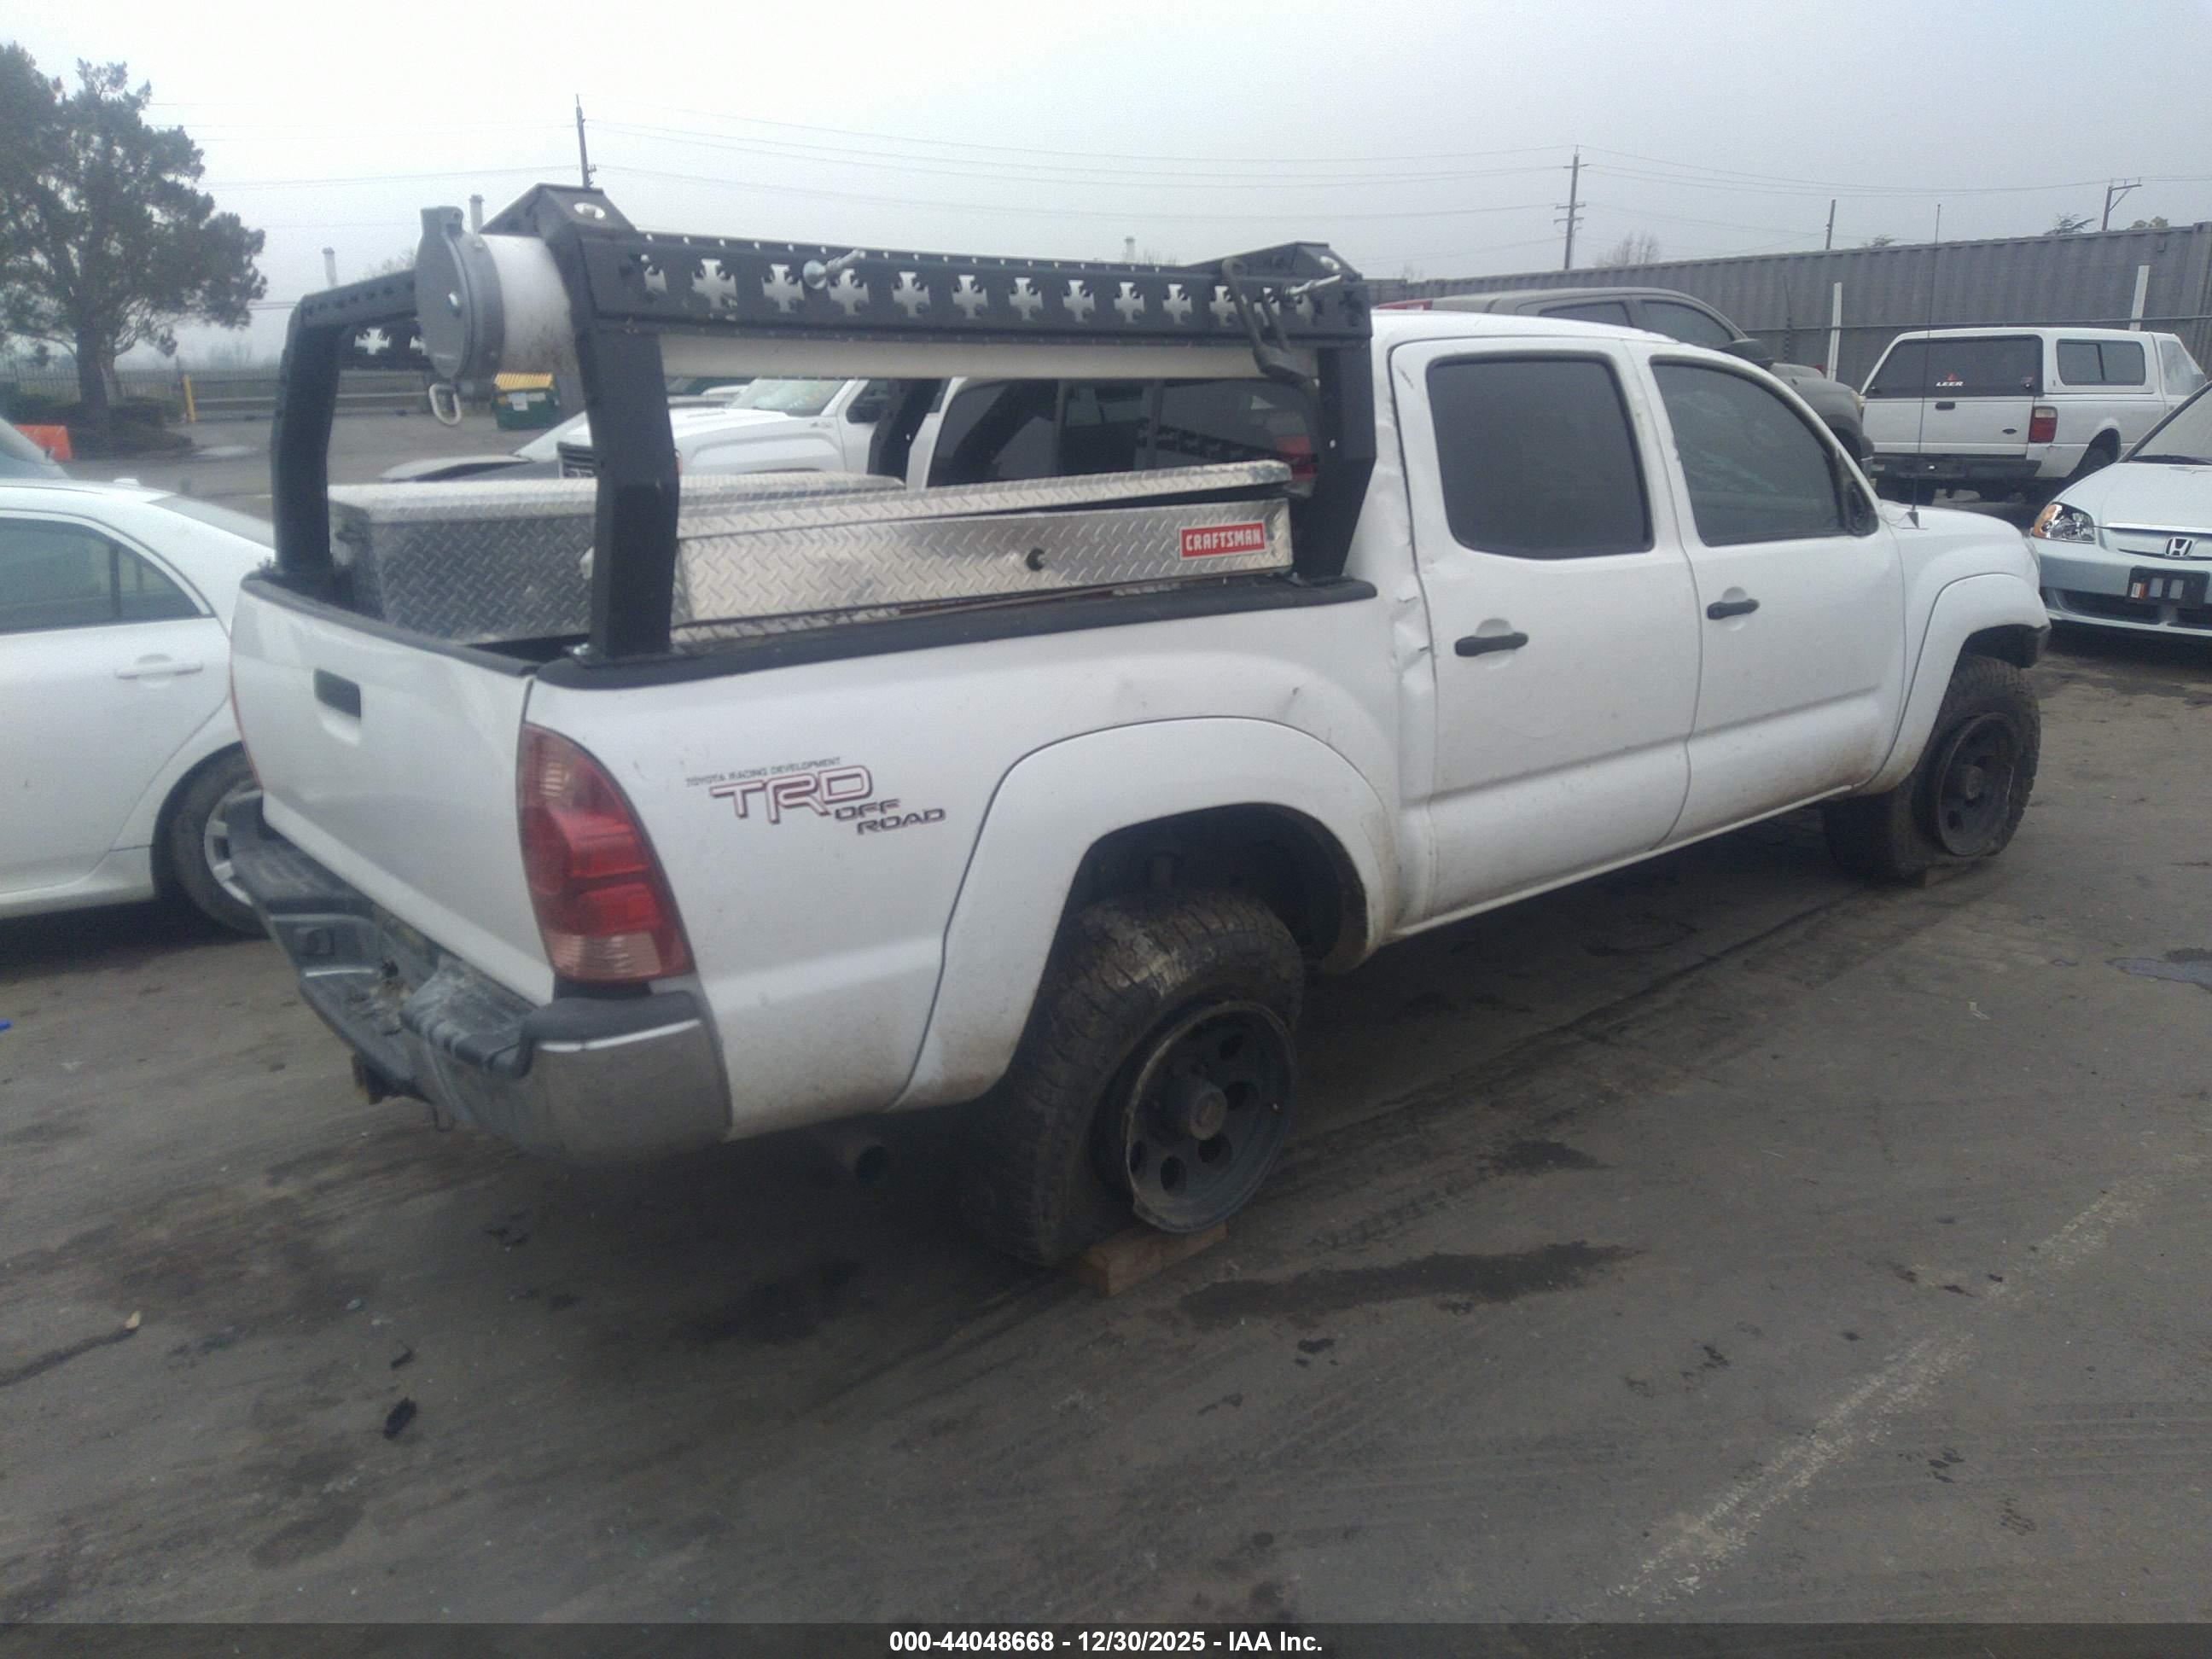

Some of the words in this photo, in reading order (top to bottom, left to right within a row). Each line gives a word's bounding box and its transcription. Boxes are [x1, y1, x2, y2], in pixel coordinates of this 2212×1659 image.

[1185, 529, 1260, 551] CRAFTSMAN
[685, 774, 726, 788] TOYOTA
[728, 767, 768, 781] RACING
[771, 756, 841, 775] DEVELOPMENT
[710, 765, 873, 824] TRD
[834, 798, 901, 822] OFF
[856, 807, 946, 835] ROAD
